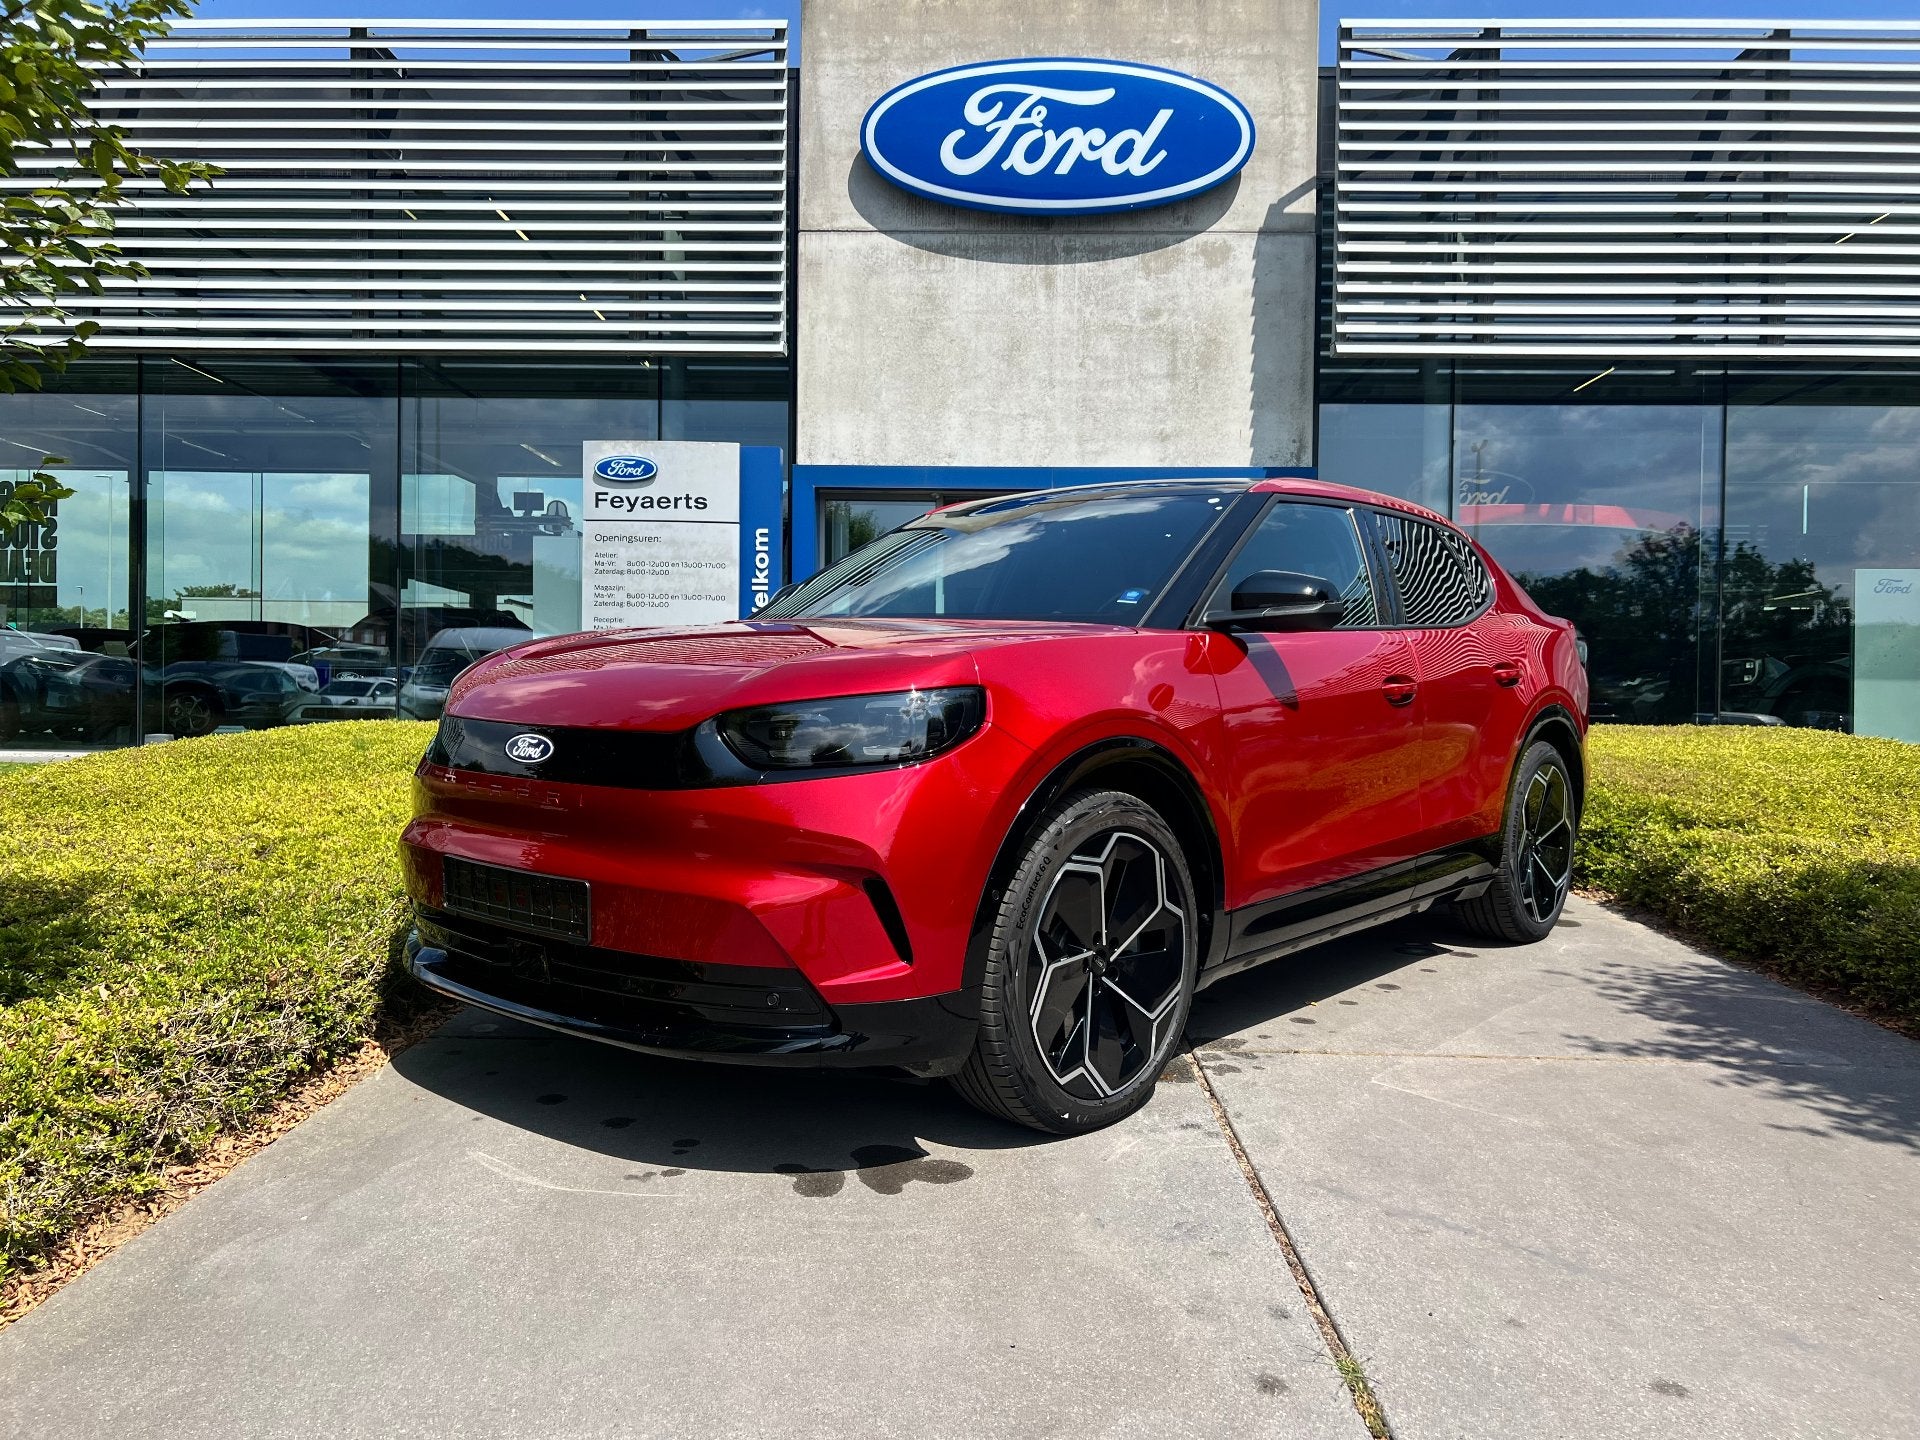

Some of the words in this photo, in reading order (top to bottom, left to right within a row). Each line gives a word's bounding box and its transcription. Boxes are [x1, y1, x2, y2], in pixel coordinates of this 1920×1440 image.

[940, 83, 1174, 177] Ford
[607, 460, 645, 476] Ford
[594, 491, 708, 513] Feyaerts
[594, 533, 662, 544] Openingsuren:
[594, 568, 626, 576] Zaterdag:
[626, 568, 670, 576] 8u00-12u00
[626, 560, 670, 568] 8u00-12u00
[751, 528, 769, 613] elkom
[593, 584, 626, 592] Magazijn:
[1873, 578, 1913, 594] Ford
[593, 616, 625, 624] Receptie:
[512, 737, 545, 759] Ford
[1016, 871, 1043, 929] EcoContact
